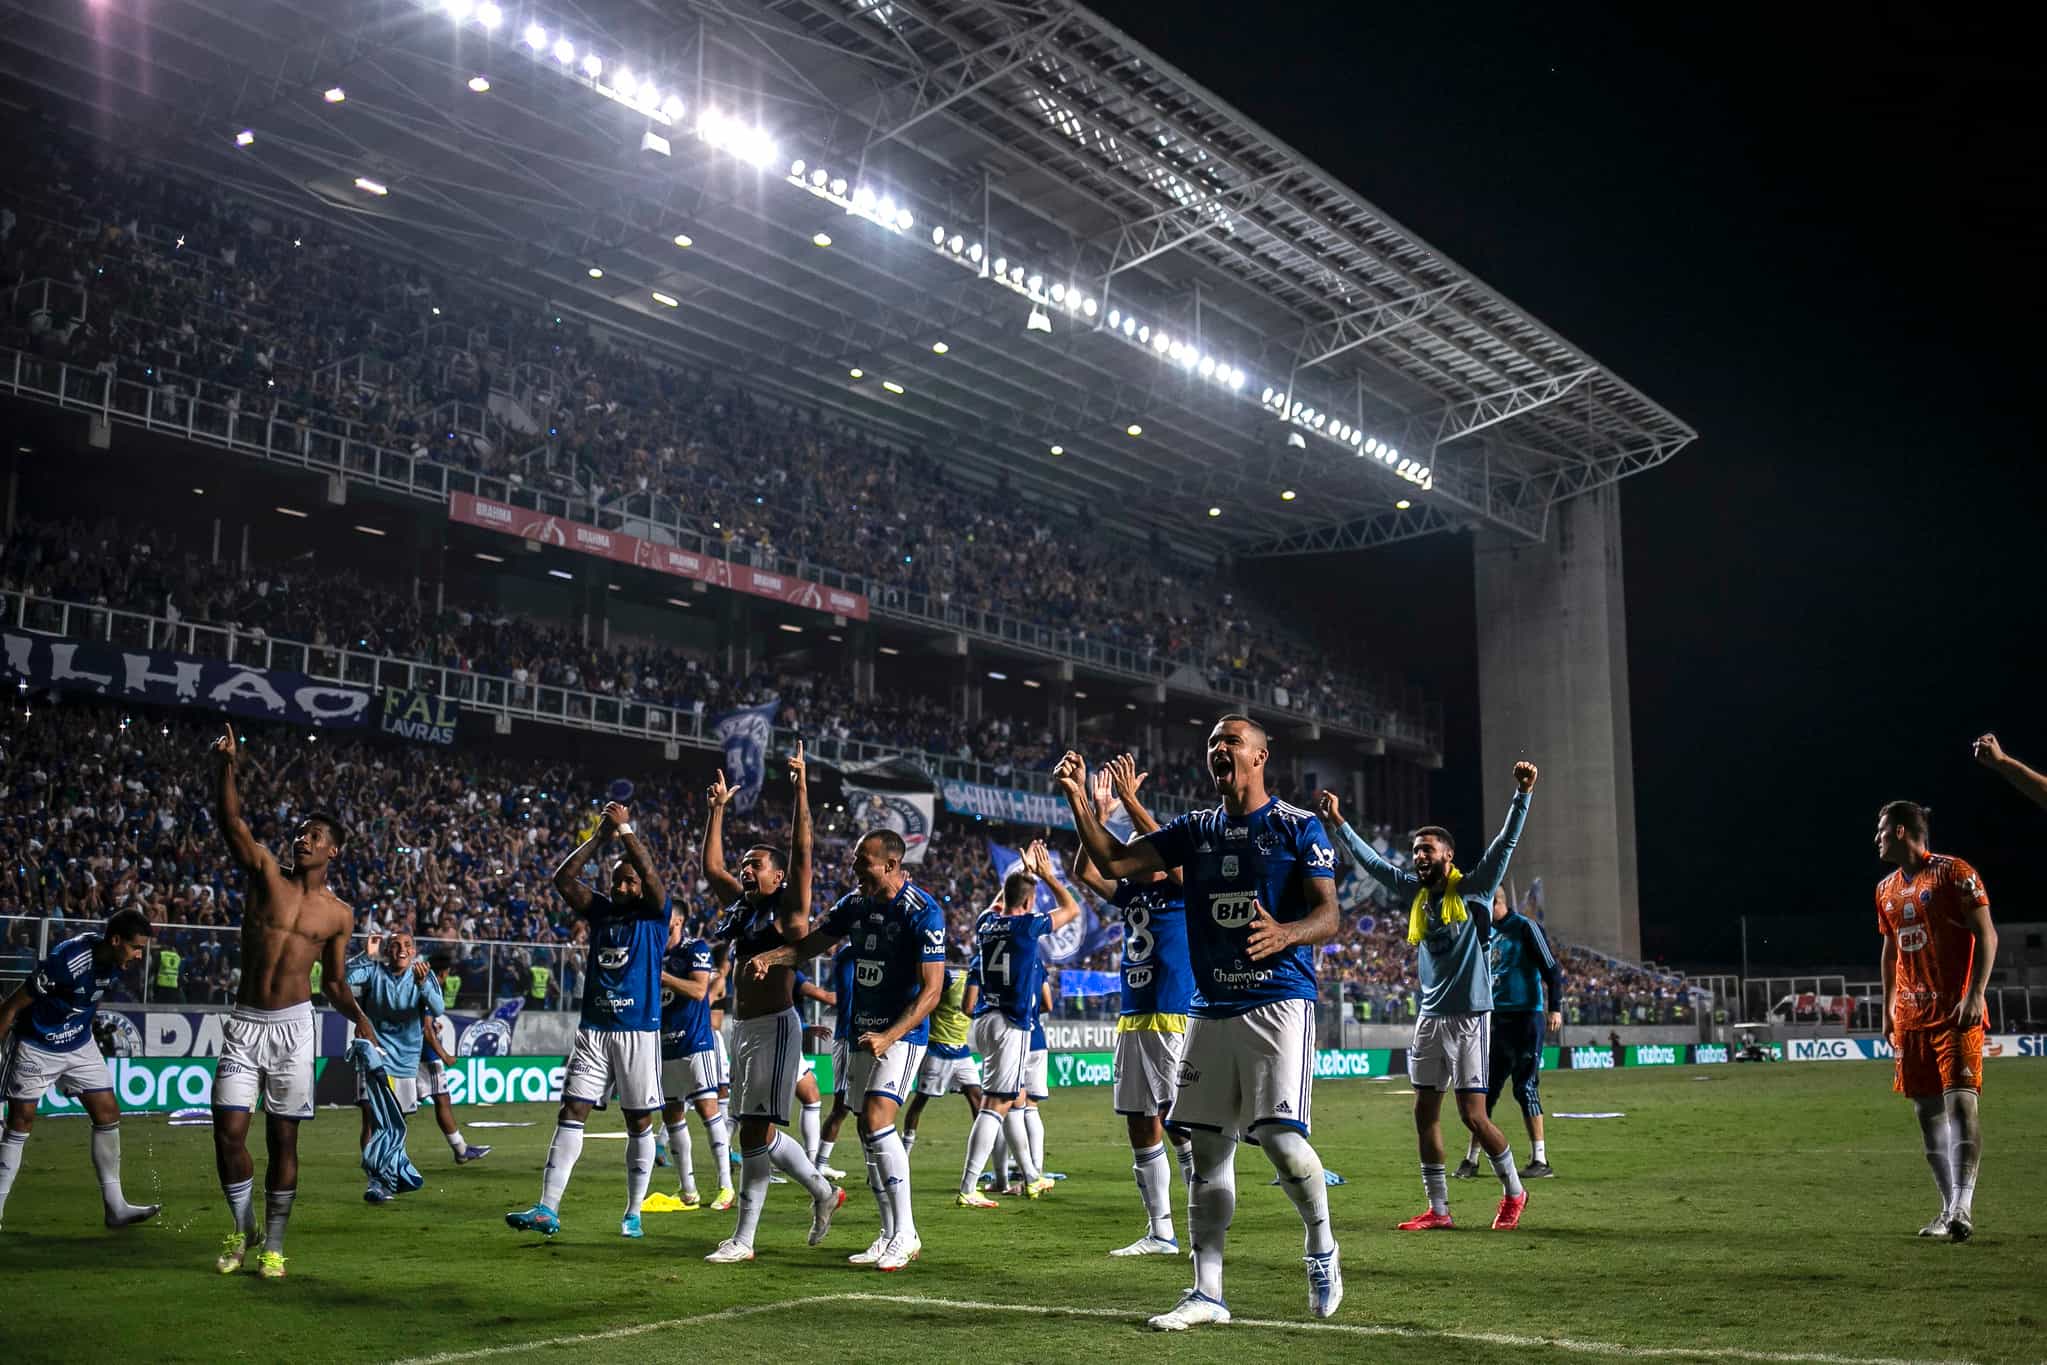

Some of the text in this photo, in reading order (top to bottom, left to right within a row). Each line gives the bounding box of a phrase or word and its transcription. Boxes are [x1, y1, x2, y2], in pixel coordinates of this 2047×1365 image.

[476, 502, 512, 523] BRAHMA
[384, 686, 457, 727] FAL
[382, 715, 454, 744] LAVRAS
[1217, 902, 1250, 920] BH
[1127, 907, 1154, 961] 8
[859, 967, 879, 981] BH
[987, 941, 1010, 986] 4
[1131, 972, 1149, 984] BH
[1213, 968, 1273, 984] Champion
[1047, 1025, 1081, 1048] RICA
[1571, 1047, 1615, 1069] intelbras
[1637, 1045, 1675, 1065] intelbras
[1796, 1042, 1848, 1058] MAG
[1076, 1059, 1111, 1085] Copa
